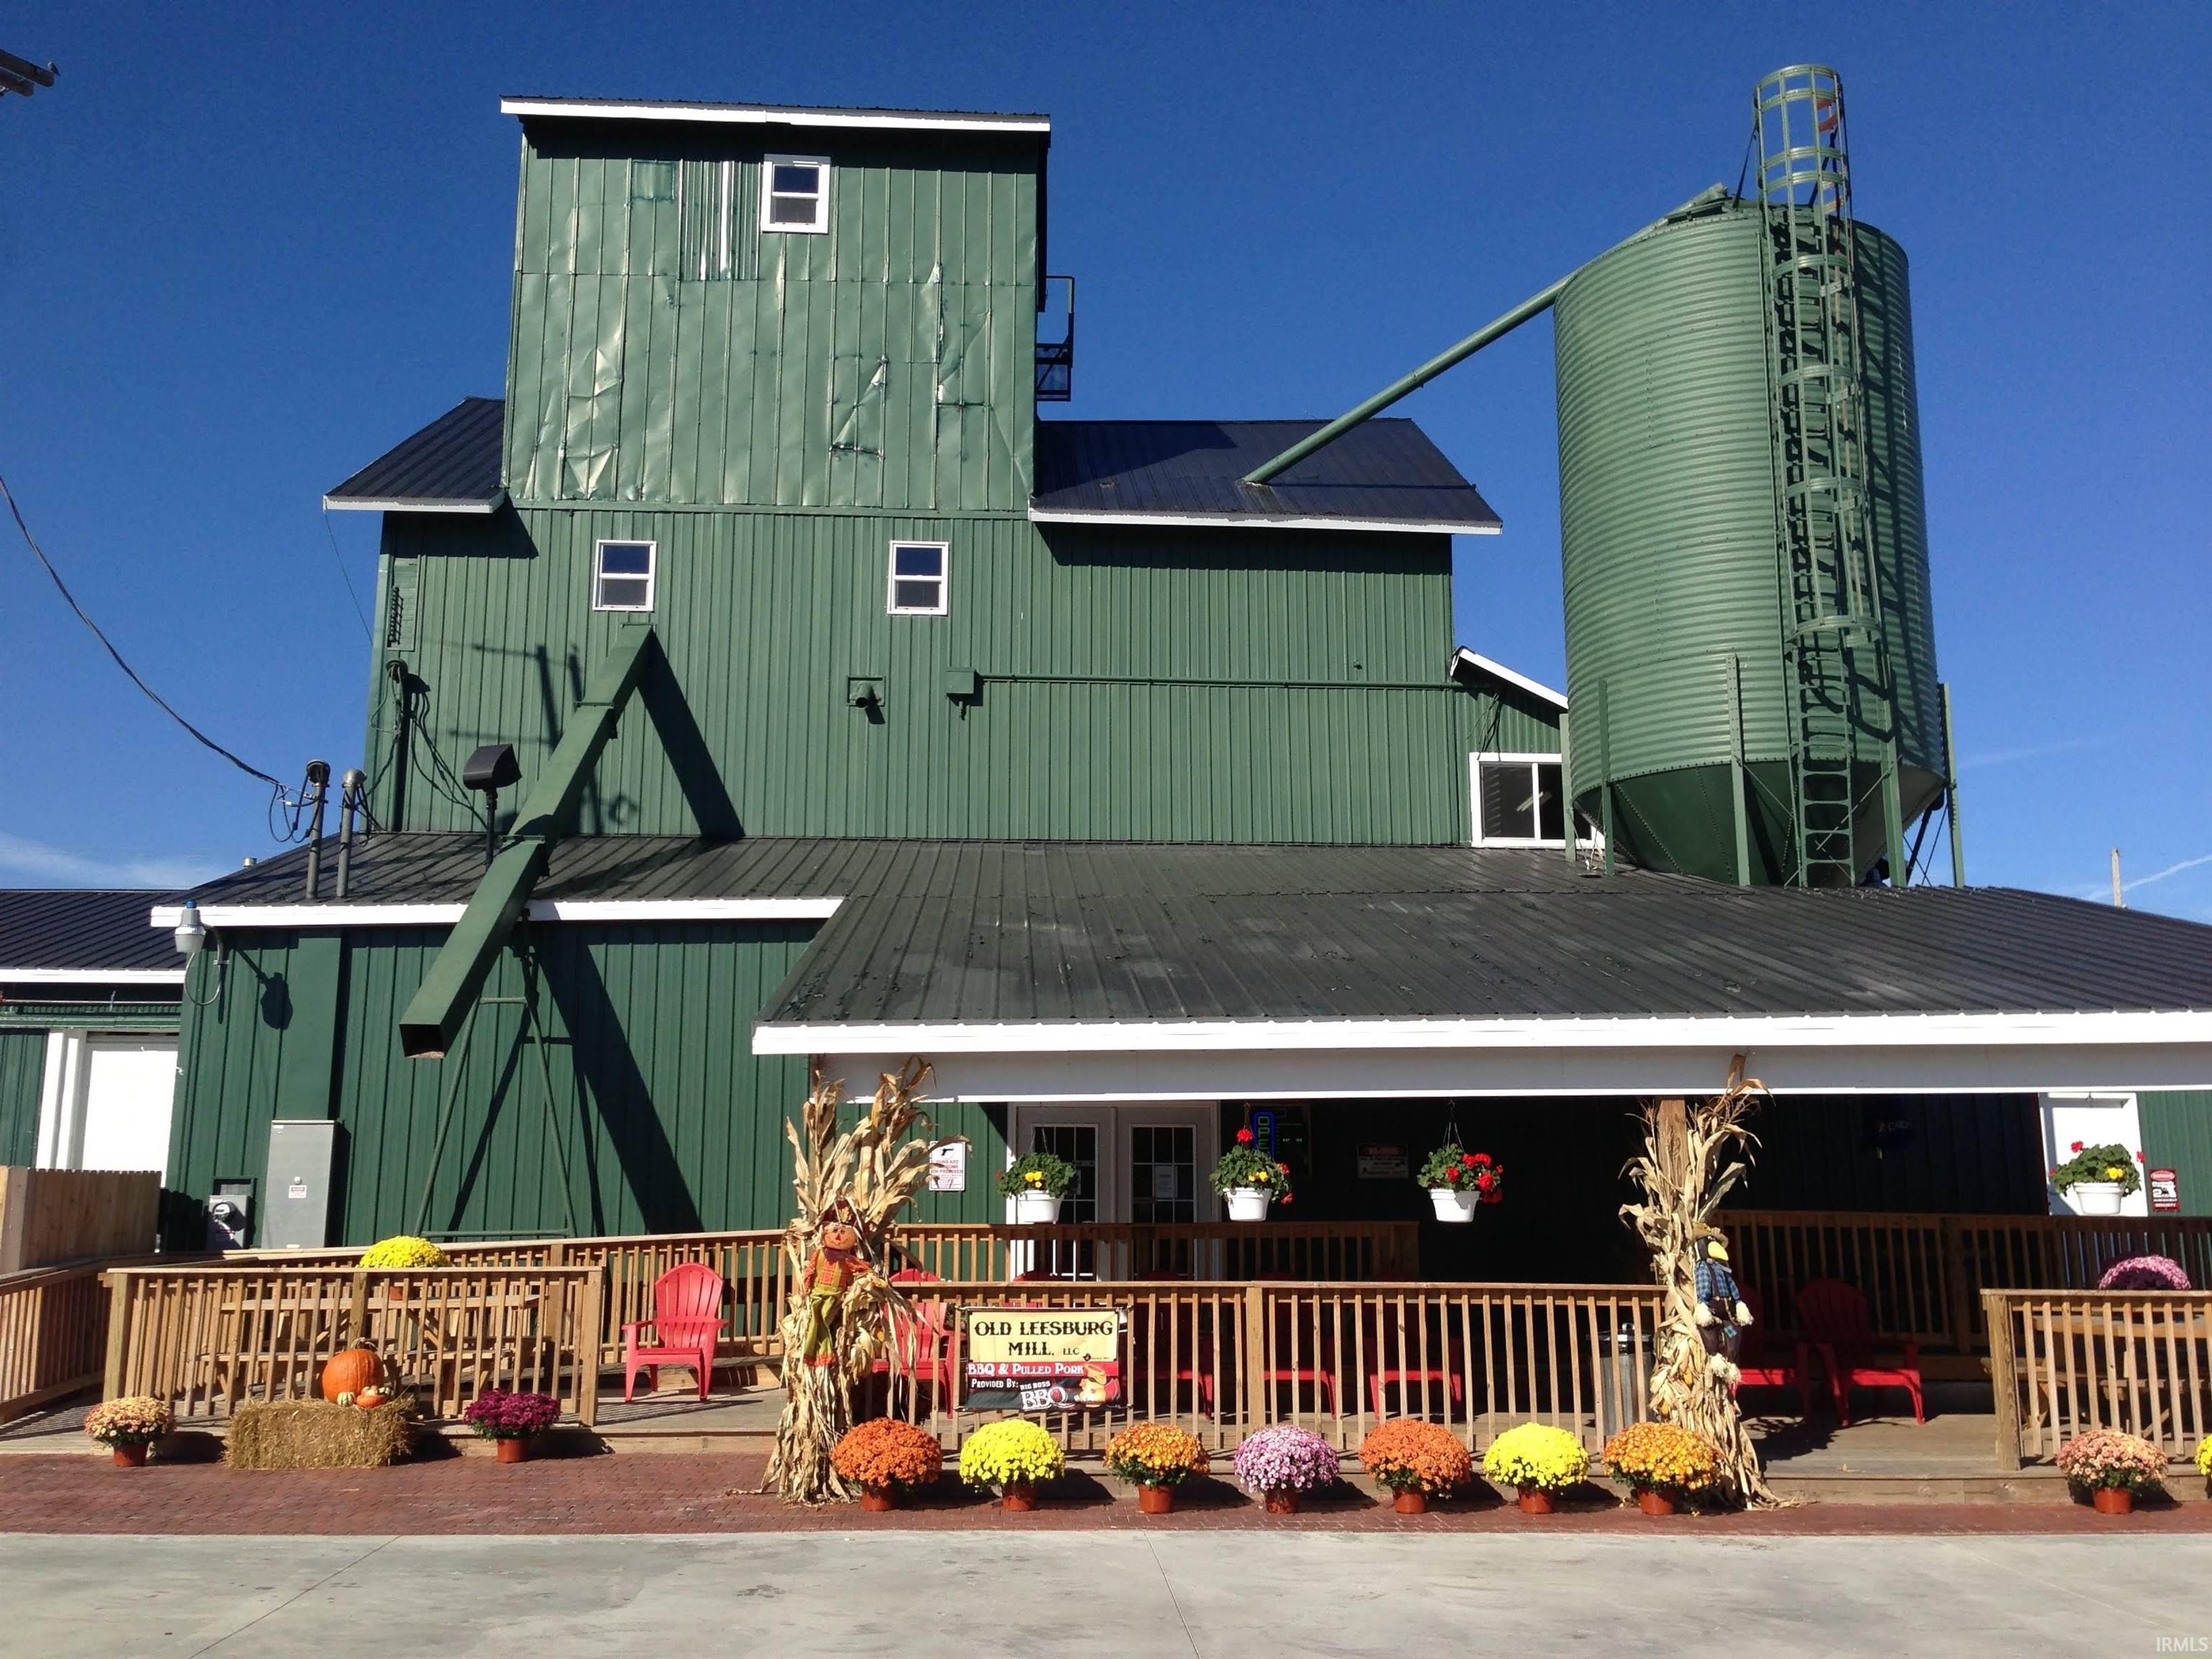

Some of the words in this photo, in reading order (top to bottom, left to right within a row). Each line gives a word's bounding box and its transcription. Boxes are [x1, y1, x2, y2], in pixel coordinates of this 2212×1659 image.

[1258, 1116, 1270, 1150] OPE
[974, 1321, 1012, 1336] OLD
[1020, 1321, 1113, 1336] LEESBURG
[967, 1363, 995, 1376] BBQ
[998, 1363, 1009, 1375] &
[1033, 1380, 1051, 1389] BOSS
[1020, 1386, 1072, 1411] BBQ
